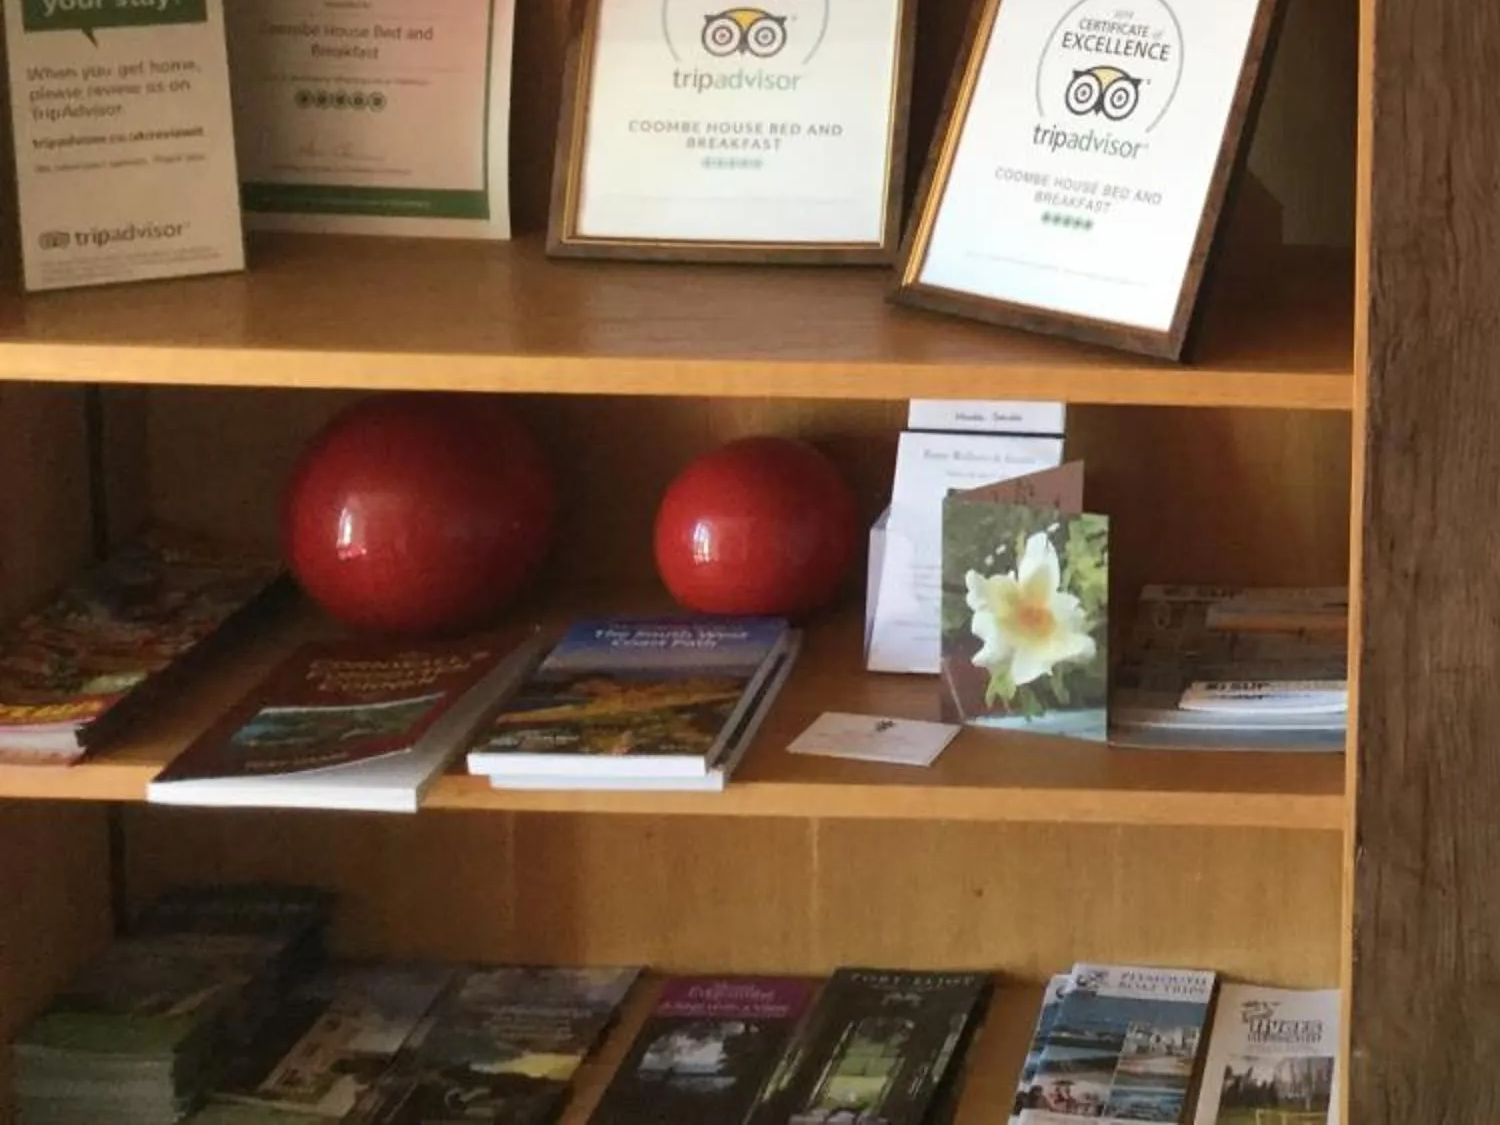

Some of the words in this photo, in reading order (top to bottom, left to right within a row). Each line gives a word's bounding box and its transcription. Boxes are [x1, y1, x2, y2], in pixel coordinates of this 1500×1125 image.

[406, 26, 434, 41] and
[1078, 17, 1150, 38] CERTIFICATE
[1061, 30, 1171, 62] EXCELLENCE
[26, 64, 78, 82] When
[81, 66, 112, 82] you
[117, 60, 145, 79] get
[672, 67, 801, 94] tripadvisor
[168, 78, 191, 93] on
[627, 119, 701, 134] COOMBE
[706, 121, 764, 135] HOUSE
[768, 122, 801, 136] BED
[806, 122, 844, 137] AND
[685, 136, 783, 153] BREAKFAST
[1033, 123, 1141, 159] tripadvisor
[994, 165, 1050, 187] COOMBE
[1053, 175, 1099, 196] HOUSE
[1102, 183, 1131, 200] BED
[1134, 188, 1163, 206] AND
[1033, 190, 1112, 213] BREAKFAST
[74, 221, 183, 247] tripadvisor
